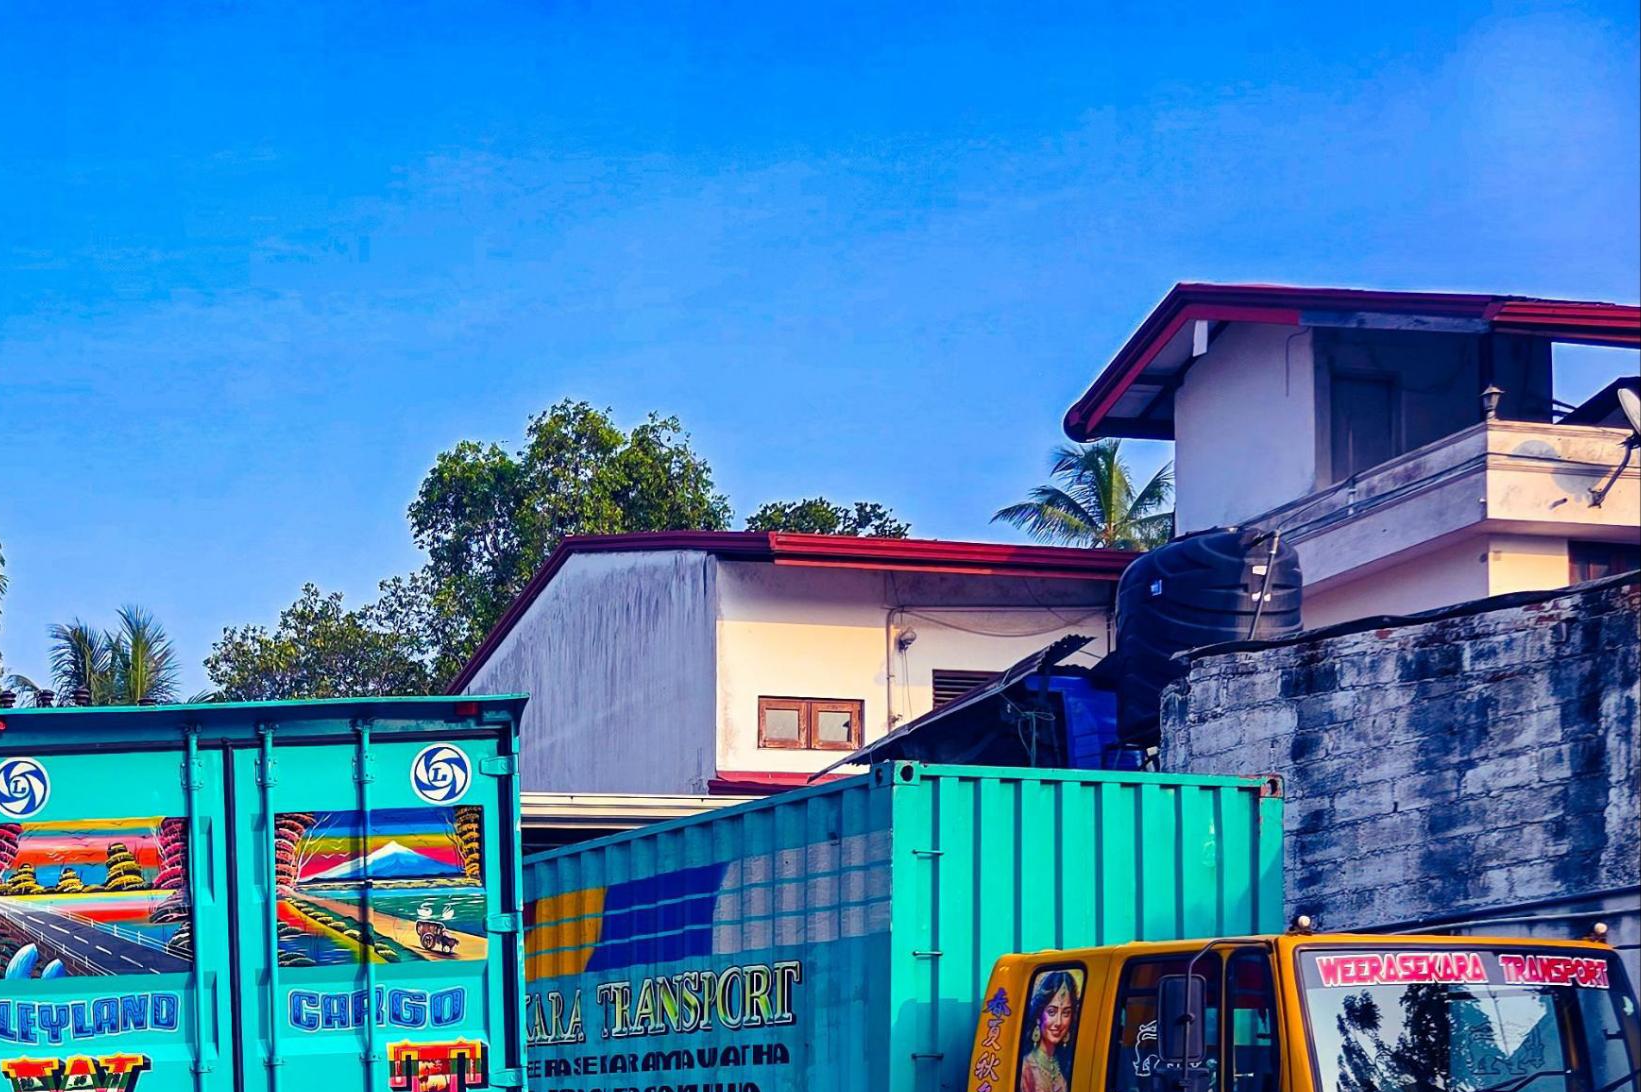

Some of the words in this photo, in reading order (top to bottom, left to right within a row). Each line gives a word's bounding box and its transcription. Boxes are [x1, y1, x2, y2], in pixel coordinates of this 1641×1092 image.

[1315, 952, 1488, 987] WEERASEKARA
[1499, 954, 1610, 989] TRANSPORT
[288, 984, 467, 1032] CARGO
[596, 960, 803, 1038] TRANSPORT
